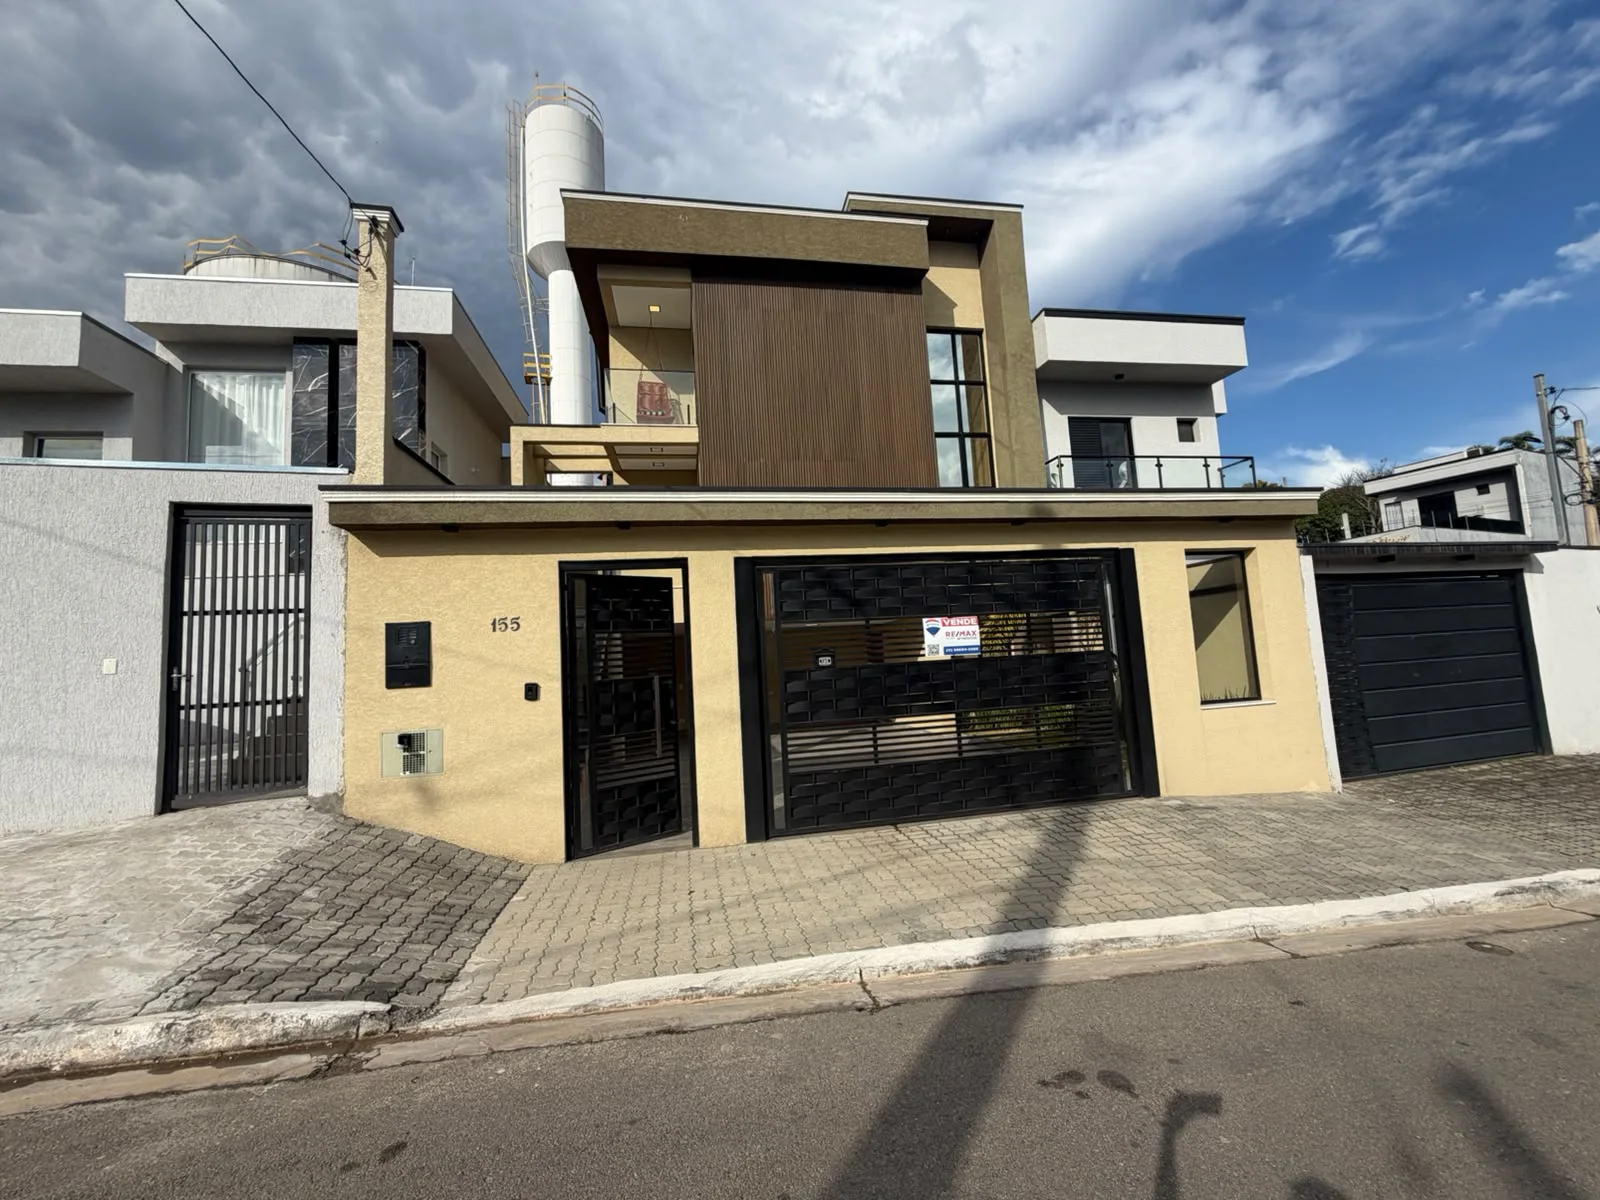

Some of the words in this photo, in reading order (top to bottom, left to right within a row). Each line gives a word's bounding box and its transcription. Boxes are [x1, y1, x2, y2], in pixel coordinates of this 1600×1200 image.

[491, 616, 521, 632] 155
[943, 617, 977, 626] VENDE
[945, 630, 977, 638] RE/MAX
